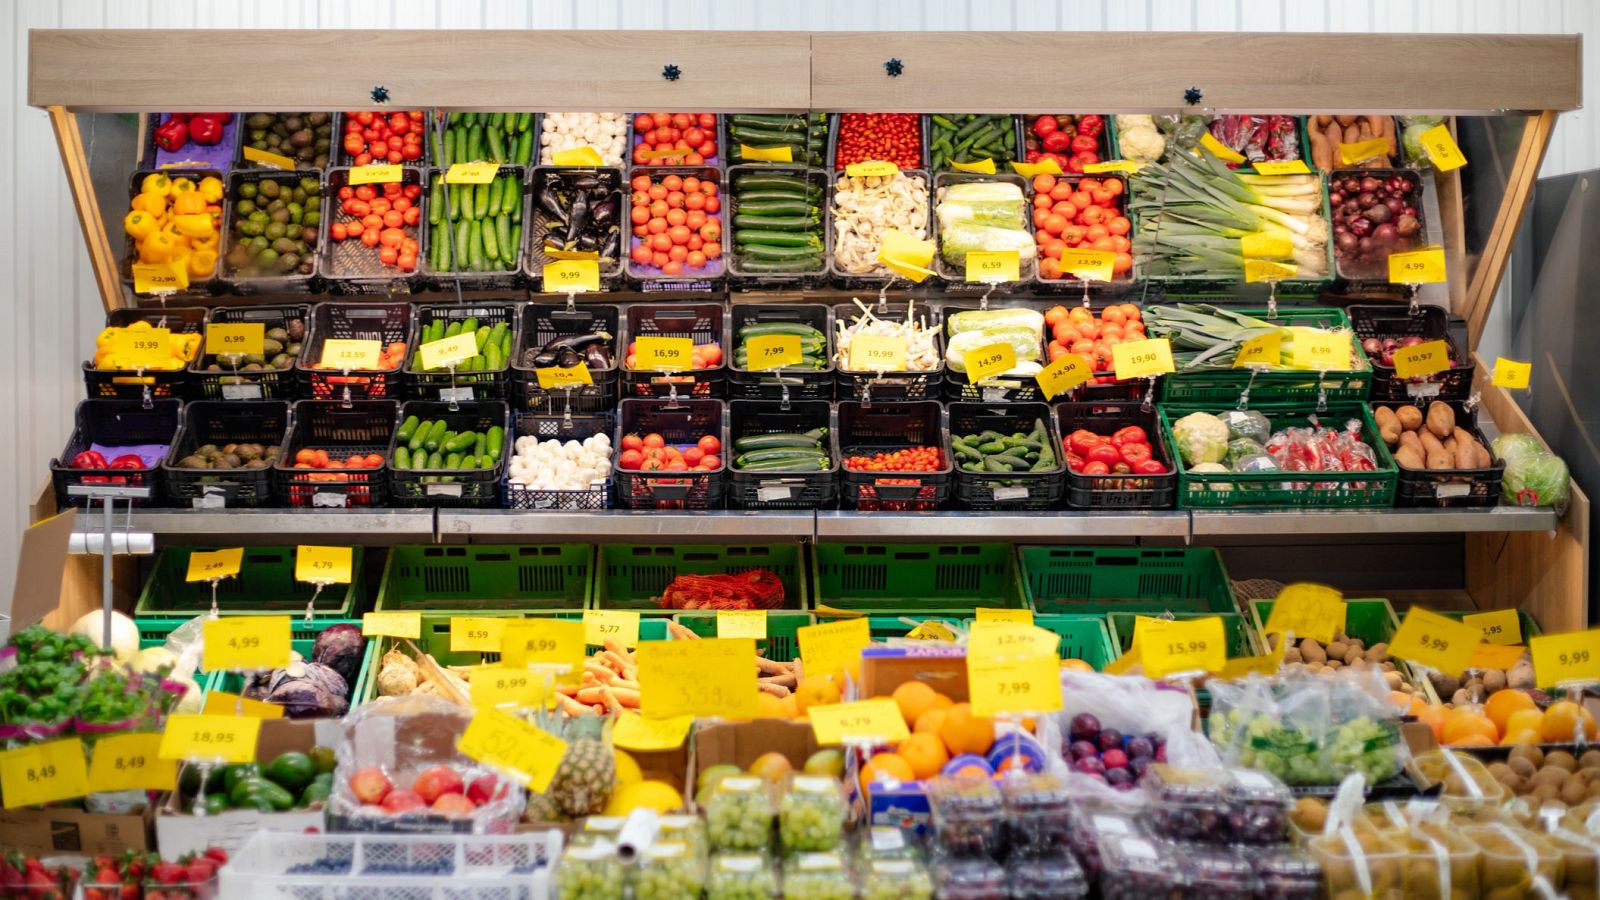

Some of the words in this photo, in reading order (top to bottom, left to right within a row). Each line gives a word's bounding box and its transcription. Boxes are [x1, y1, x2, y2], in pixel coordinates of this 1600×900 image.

[982, 262, 1001, 270] 6,59
[1405, 263, 1424, 271] 4,99
[560, 272, 580, 280] 9,99
[135, 341, 158, 349] 19,99
[224, 336, 245, 344] 0,99
[654, 350, 679, 358] 16,99
[764, 347, 784, 357] 7,99
[868, 350, 893, 359] 19,99
[1311, 346, 1331, 355] 6,99
[978, 354, 1002, 367] 14,99
[1131, 353, 1156, 364] 19,90
[1408, 353, 1432, 362] 10,97
[1052, 363, 1076, 379] 24,90
[313, 561, 333, 569] 4,79
[468, 630, 488, 638] 8,59
[600, 625, 620, 633] 5,77
[228, 637, 259, 649] 4,99
[525, 640, 556, 651] 8,99
[1168, 641, 1207, 655] 15,99
[1420, 635, 1448, 651] 9,99
[1559, 650, 1589, 665] 9,99
[496, 678, 527, 689] 8,99
[999, 682, 1030, 695] 7,99
[840, 717, 871, 728] 6,79
[193, 731, 234, 743] 18,95
[116, 756, 145, 770] 8,49
[27, 765, 56, 782] 8,49
